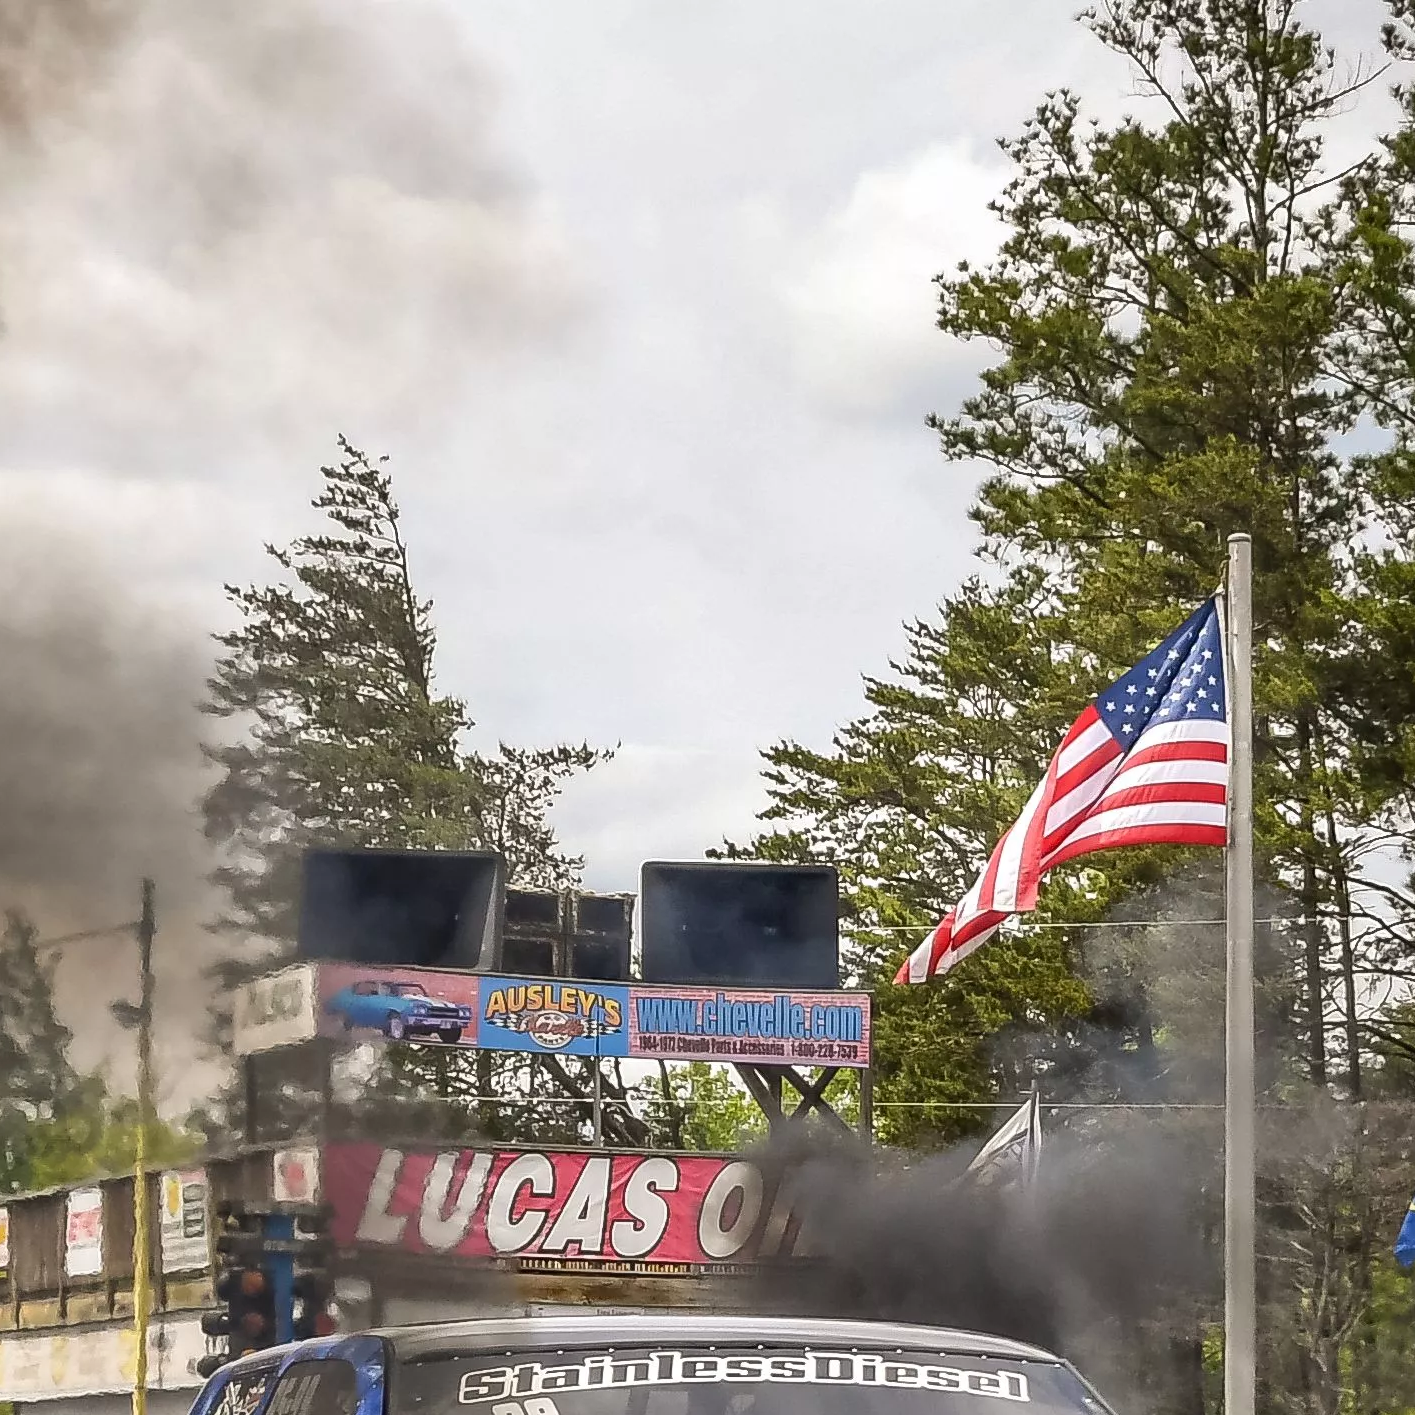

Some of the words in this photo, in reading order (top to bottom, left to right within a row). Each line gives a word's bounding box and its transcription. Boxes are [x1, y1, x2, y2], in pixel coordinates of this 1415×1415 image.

[485, 985, 623, 1028] AUSLEY'S
[636, 993, 863, 1042] www.chevelle.com
[354, 1147, 680, 1258] LUCAS
